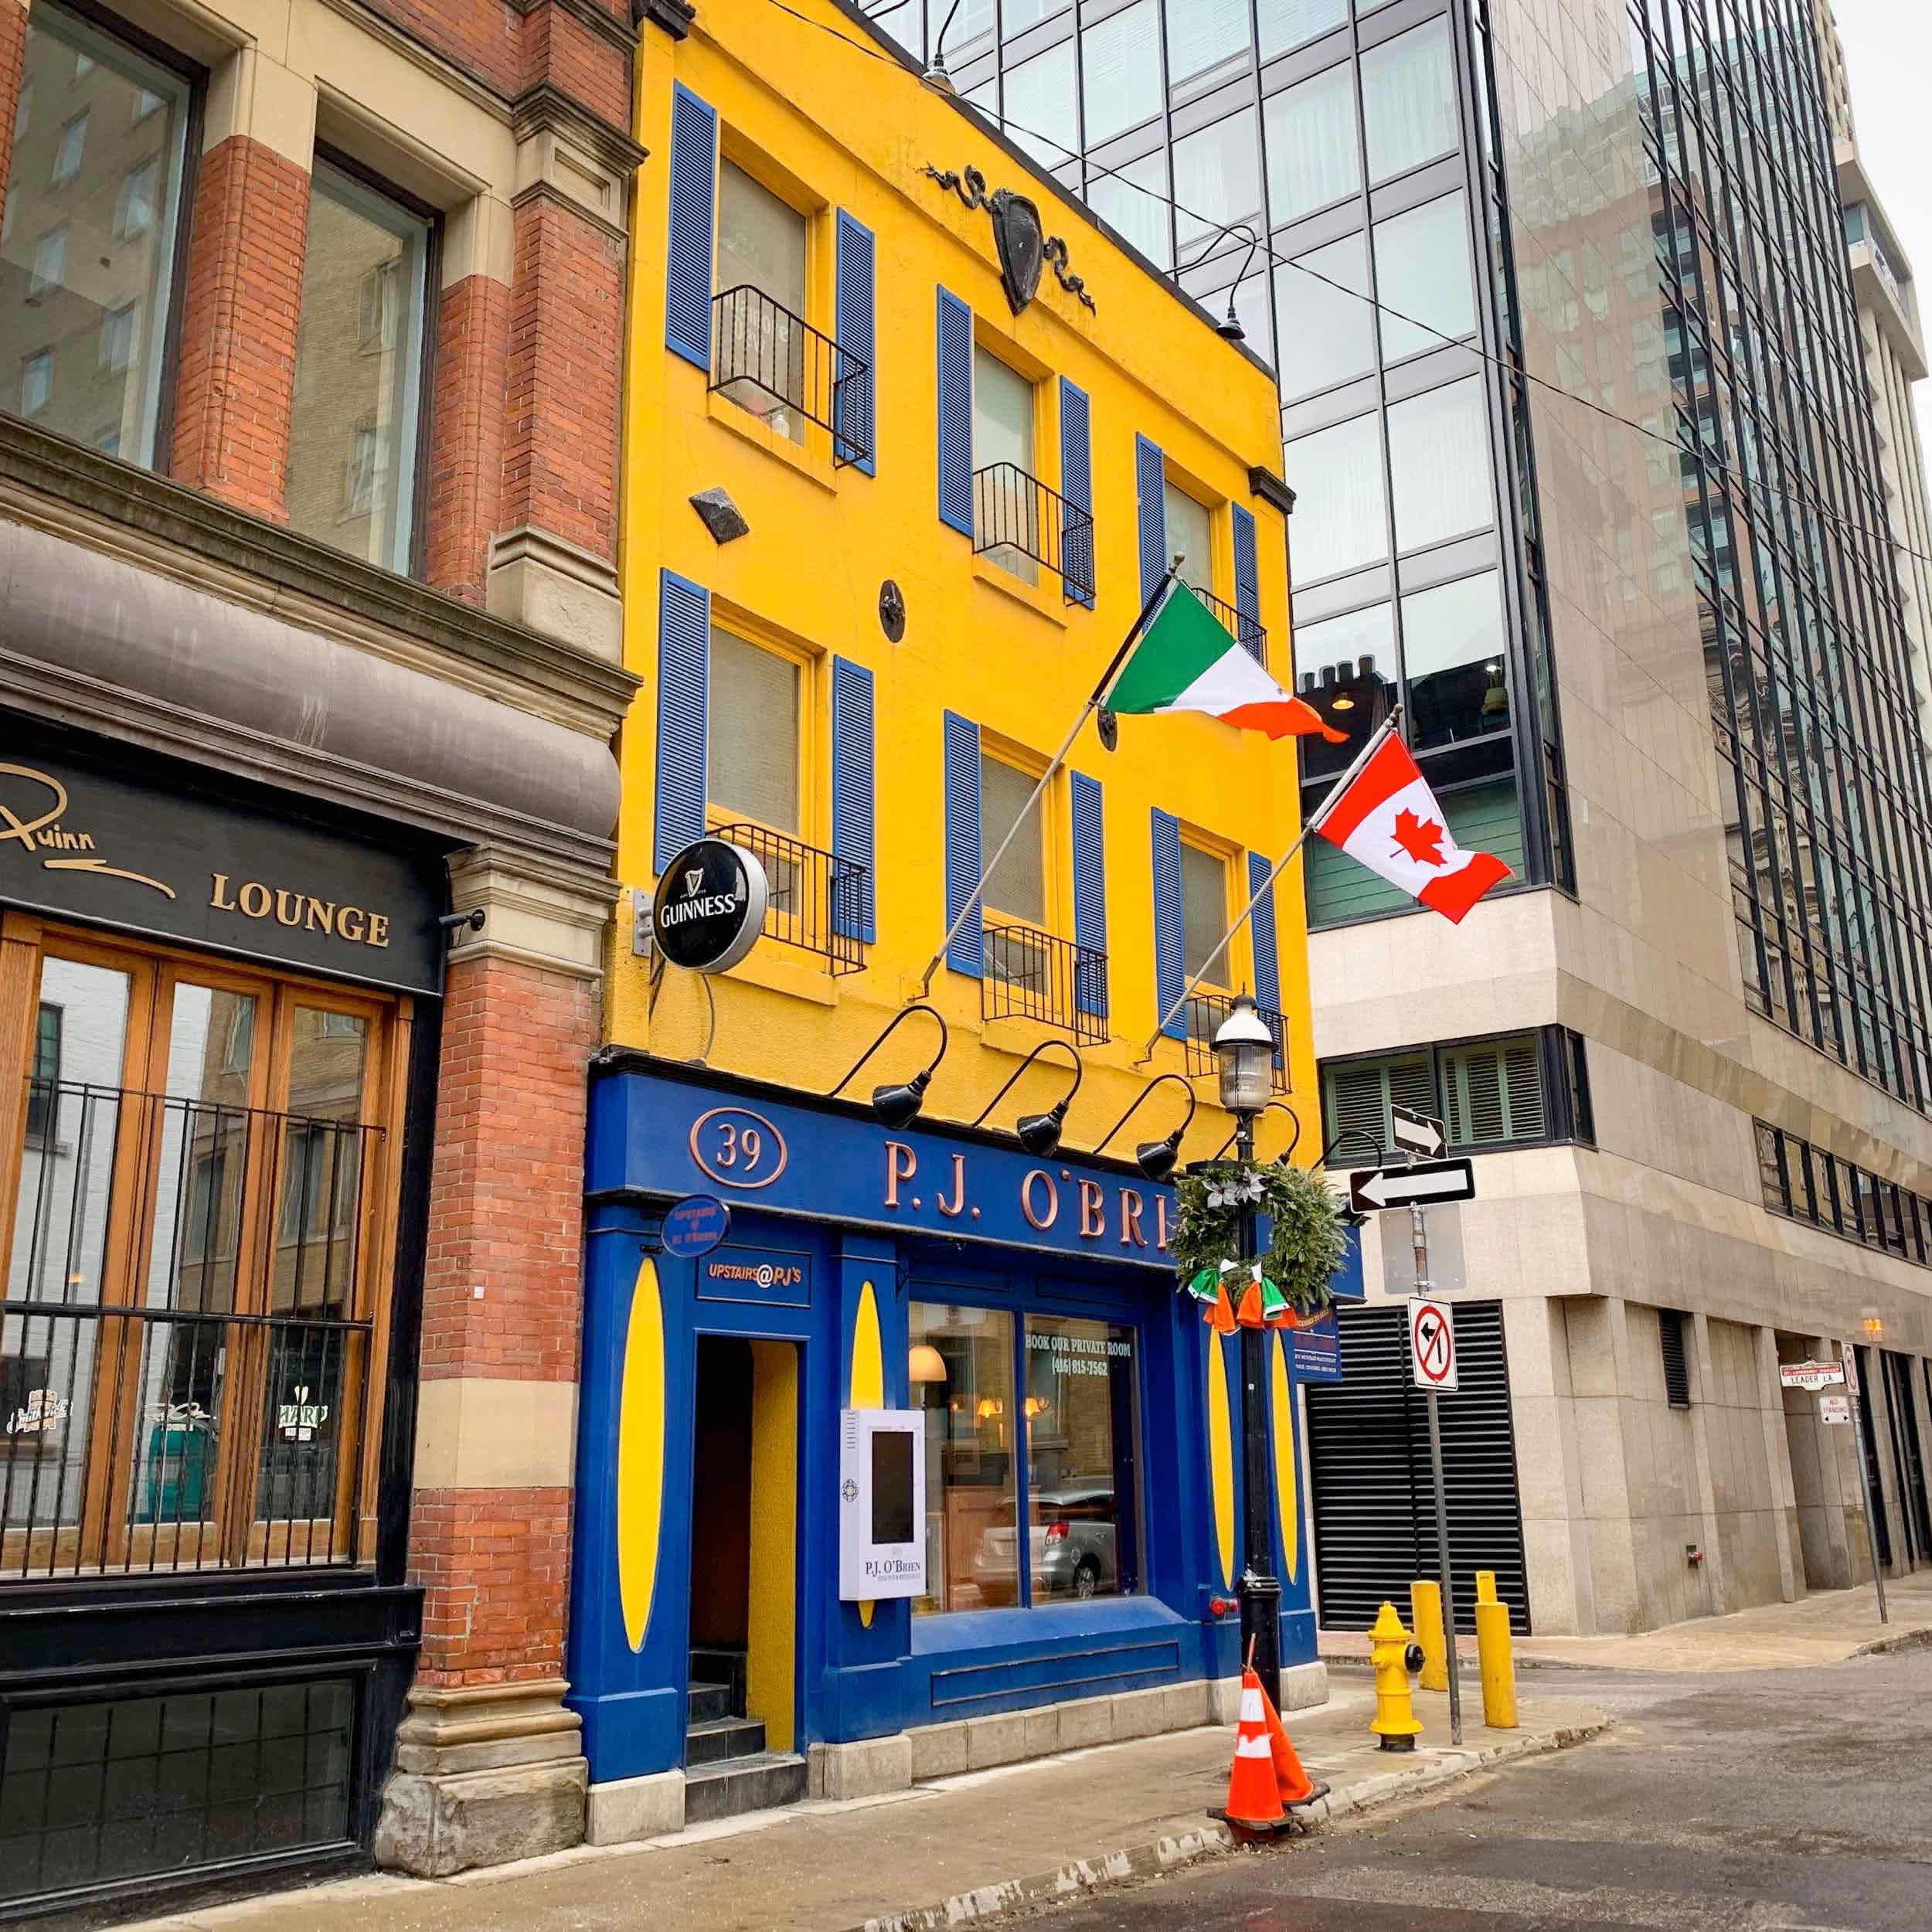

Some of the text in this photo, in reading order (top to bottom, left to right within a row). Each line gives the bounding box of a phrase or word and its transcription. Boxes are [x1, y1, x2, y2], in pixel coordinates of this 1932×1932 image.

[210, 872, 390, 948] LOUNGE
[661, 893, 736, 928] GUINNESS
[716, 1123, 761, 1172] 39
[883, 1141, 1168, 1250] P.J. O'BRI
[1025, 1335, 1131, 1357] BOOK OUR PRIVATE ROOM
[1051, 1355, 1108, 1376] (416) 815-7562
[1791, 1375, 1818, 1384] LEADER
[866, 1561, 881, 1577] P.J.
